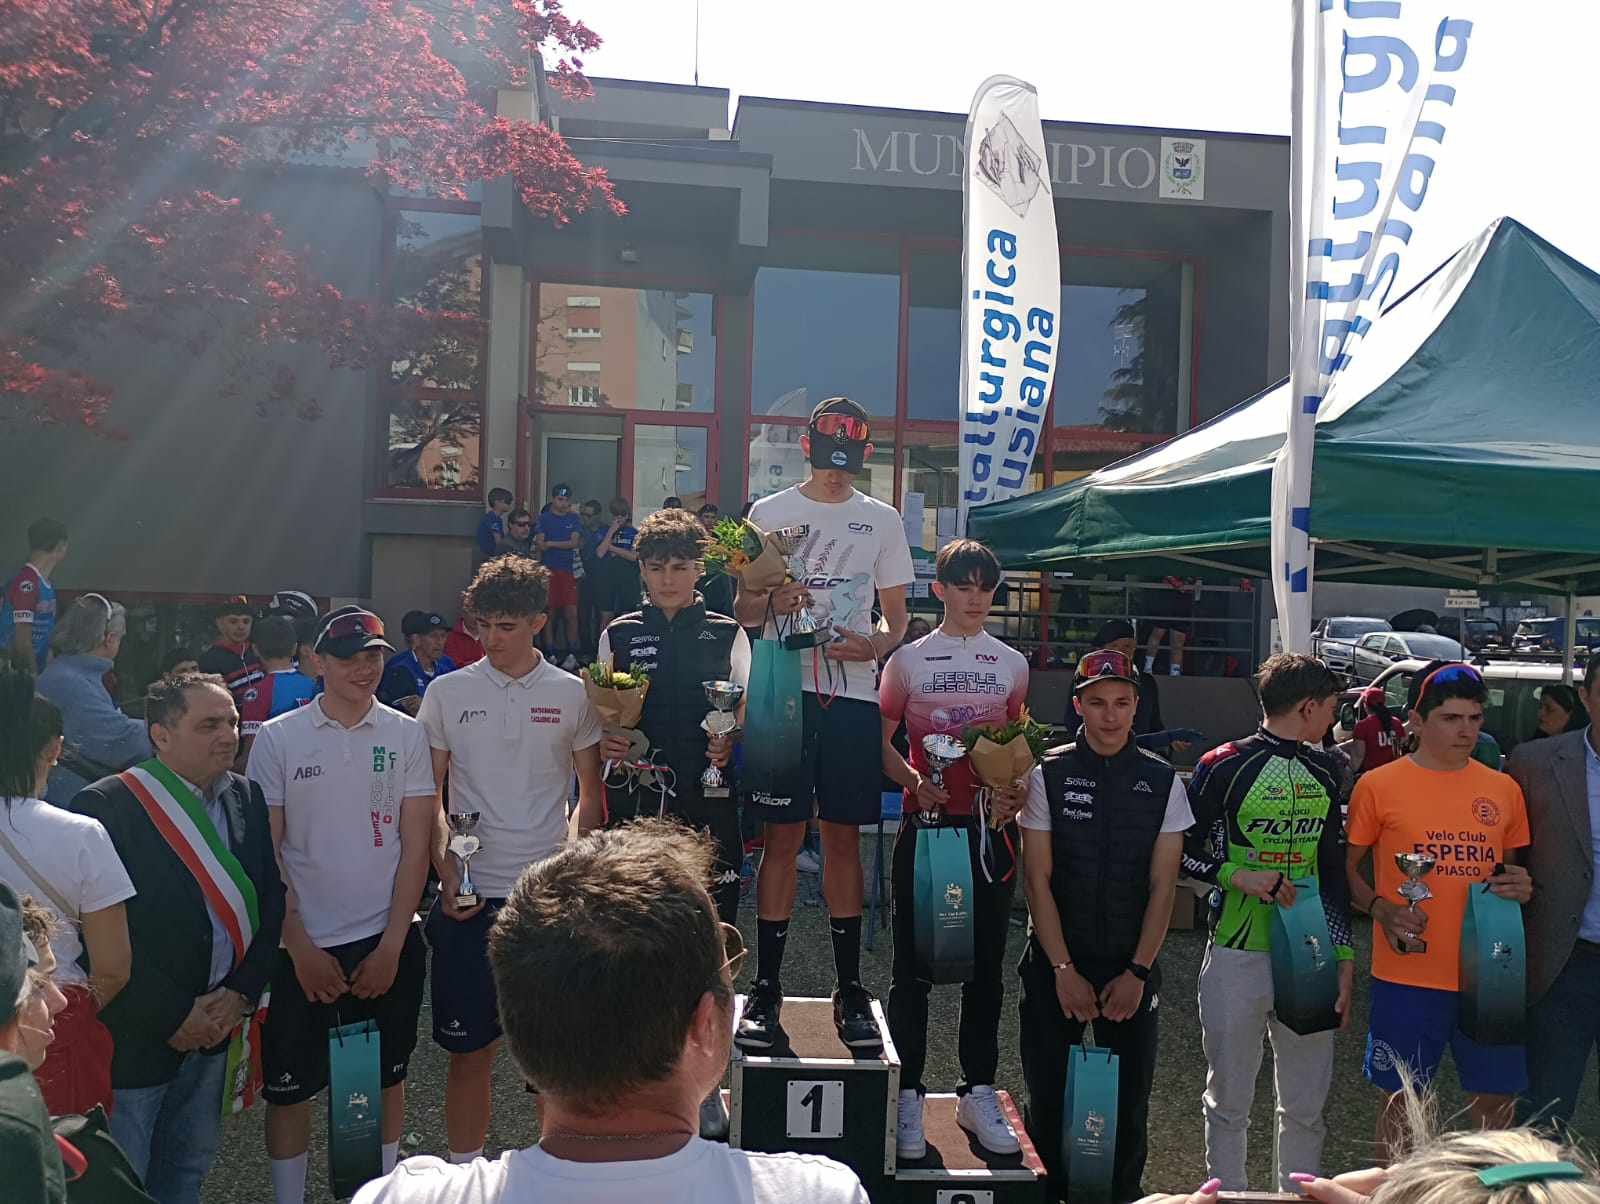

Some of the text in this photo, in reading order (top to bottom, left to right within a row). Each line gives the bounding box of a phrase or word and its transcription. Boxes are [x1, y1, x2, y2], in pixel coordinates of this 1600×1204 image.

[850, 128, 1156, 189] MUIPIO
[1426, 831, 1487, 842] Velo Club
[1436, 865, 1481, 877] PIASCO
[801, 1084, 823, 1133] 1
